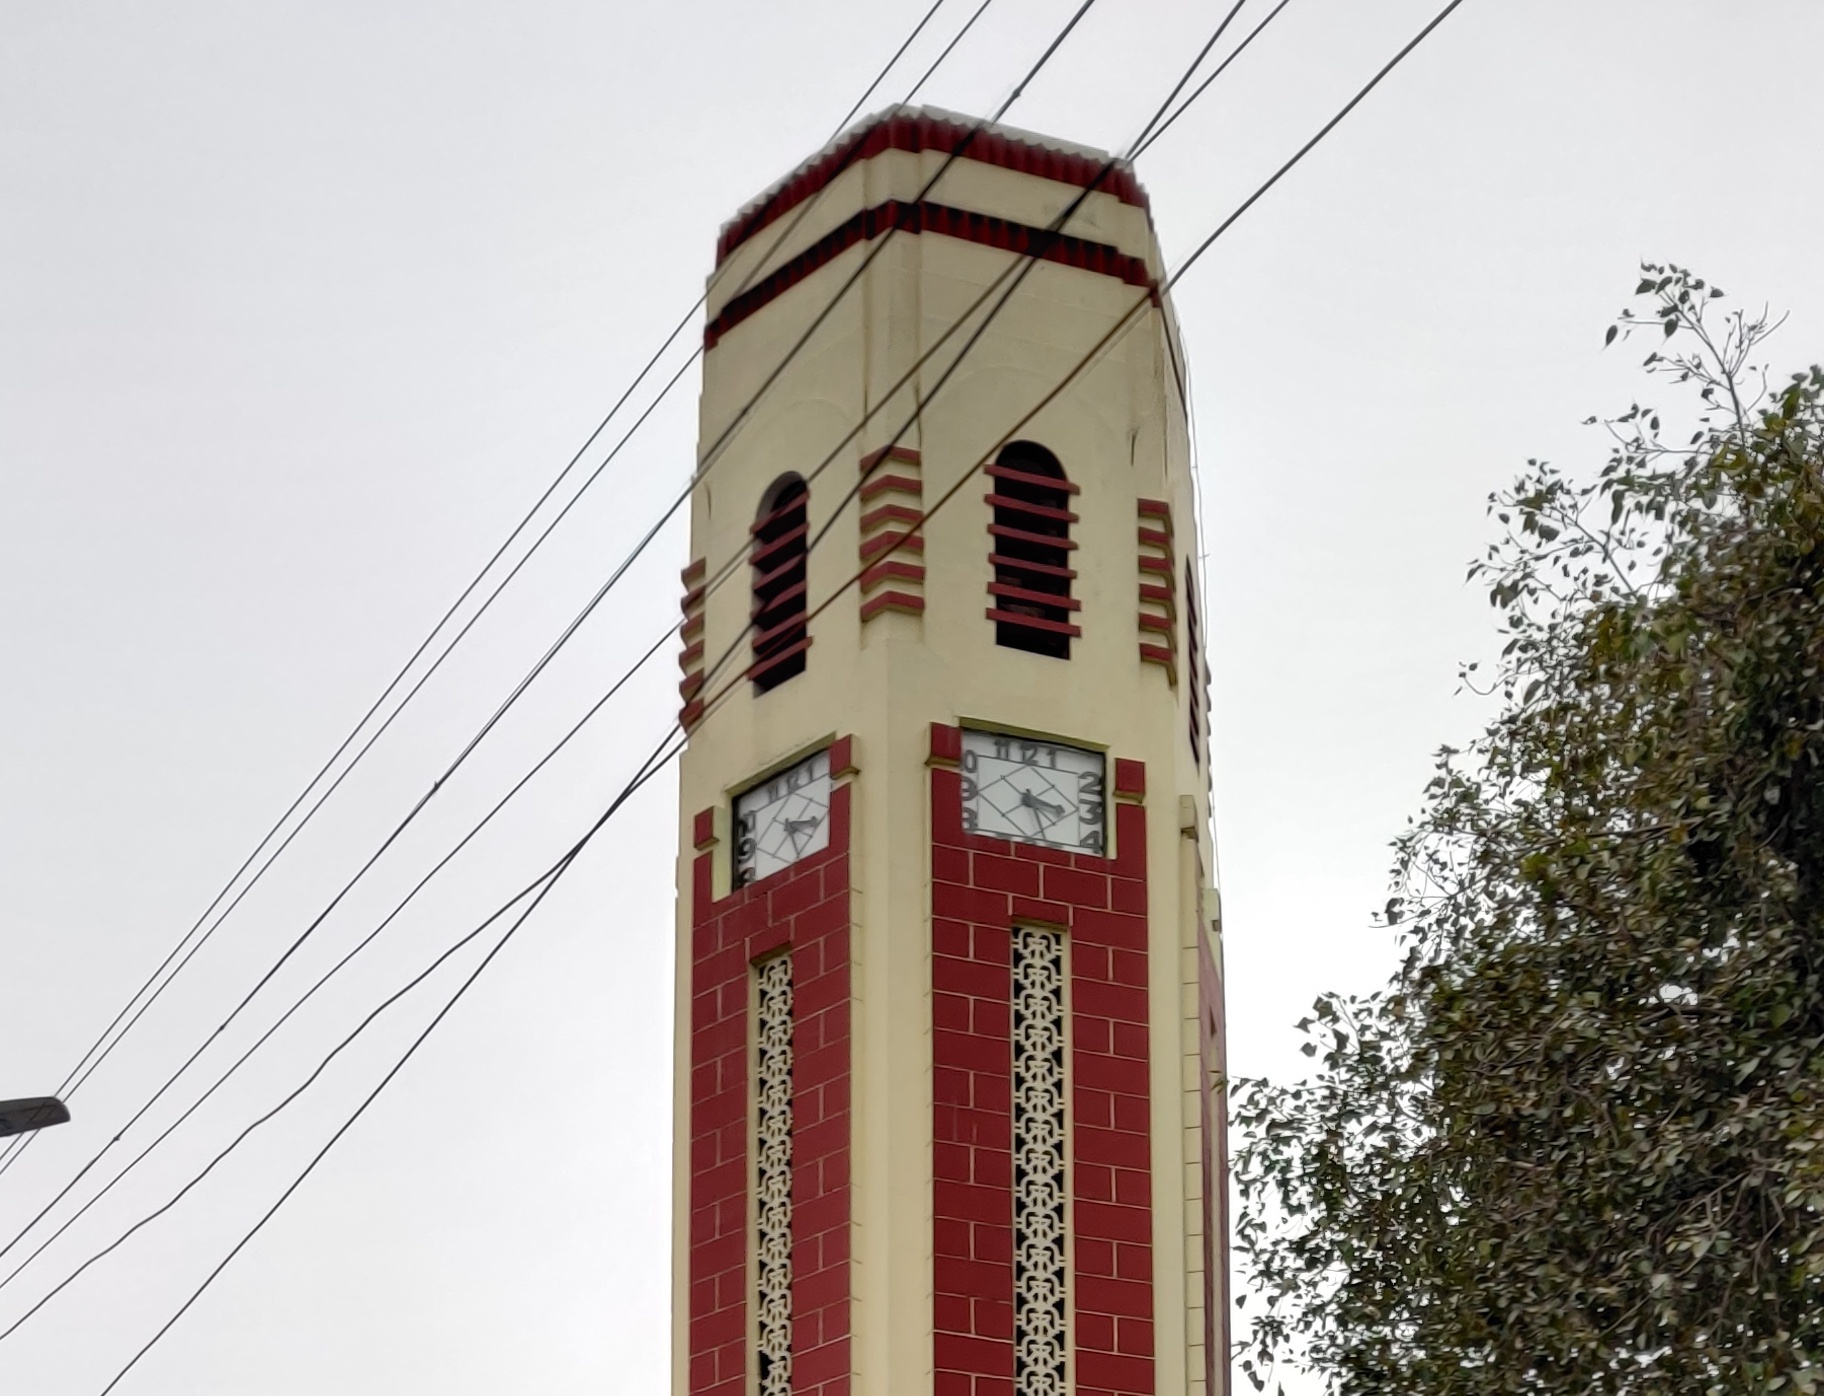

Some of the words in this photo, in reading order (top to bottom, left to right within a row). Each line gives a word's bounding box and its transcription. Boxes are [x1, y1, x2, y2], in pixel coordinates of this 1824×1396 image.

[1078, 771, 1102, 796] 2
[1078, 798, 1102, 826] 3
[1079, 829, 1103, 854] 4
